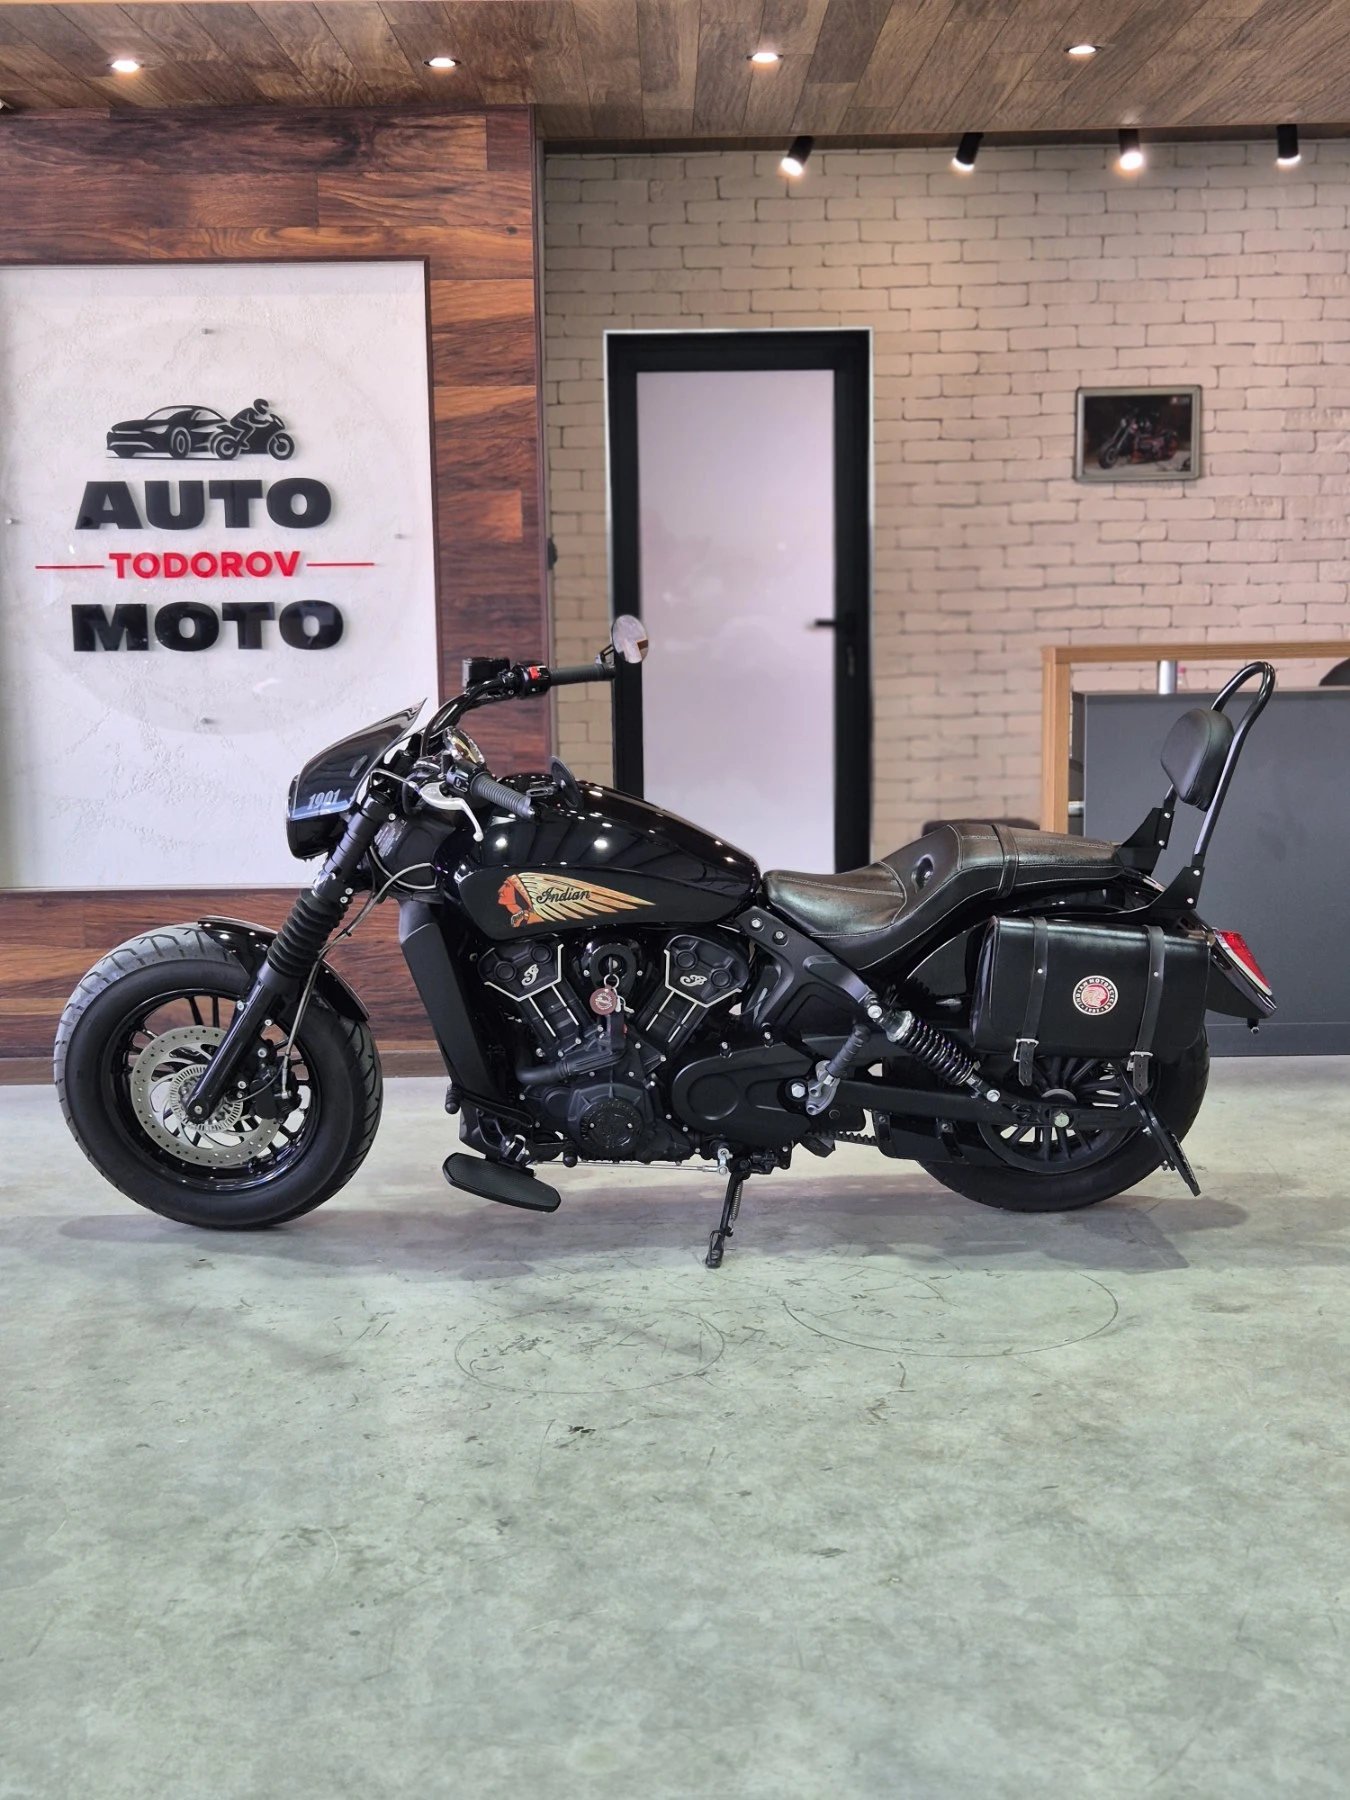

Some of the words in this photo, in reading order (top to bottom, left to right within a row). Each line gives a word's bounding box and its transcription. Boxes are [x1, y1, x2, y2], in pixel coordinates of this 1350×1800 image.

[75, 478, 332, 530] AUTO
[109, 551, 300, 579] TODOROV
[71, 600, 344, 652] MOTO
[307, 788, 341, 810] 1901
[536, 887, 591, 904] Indian
